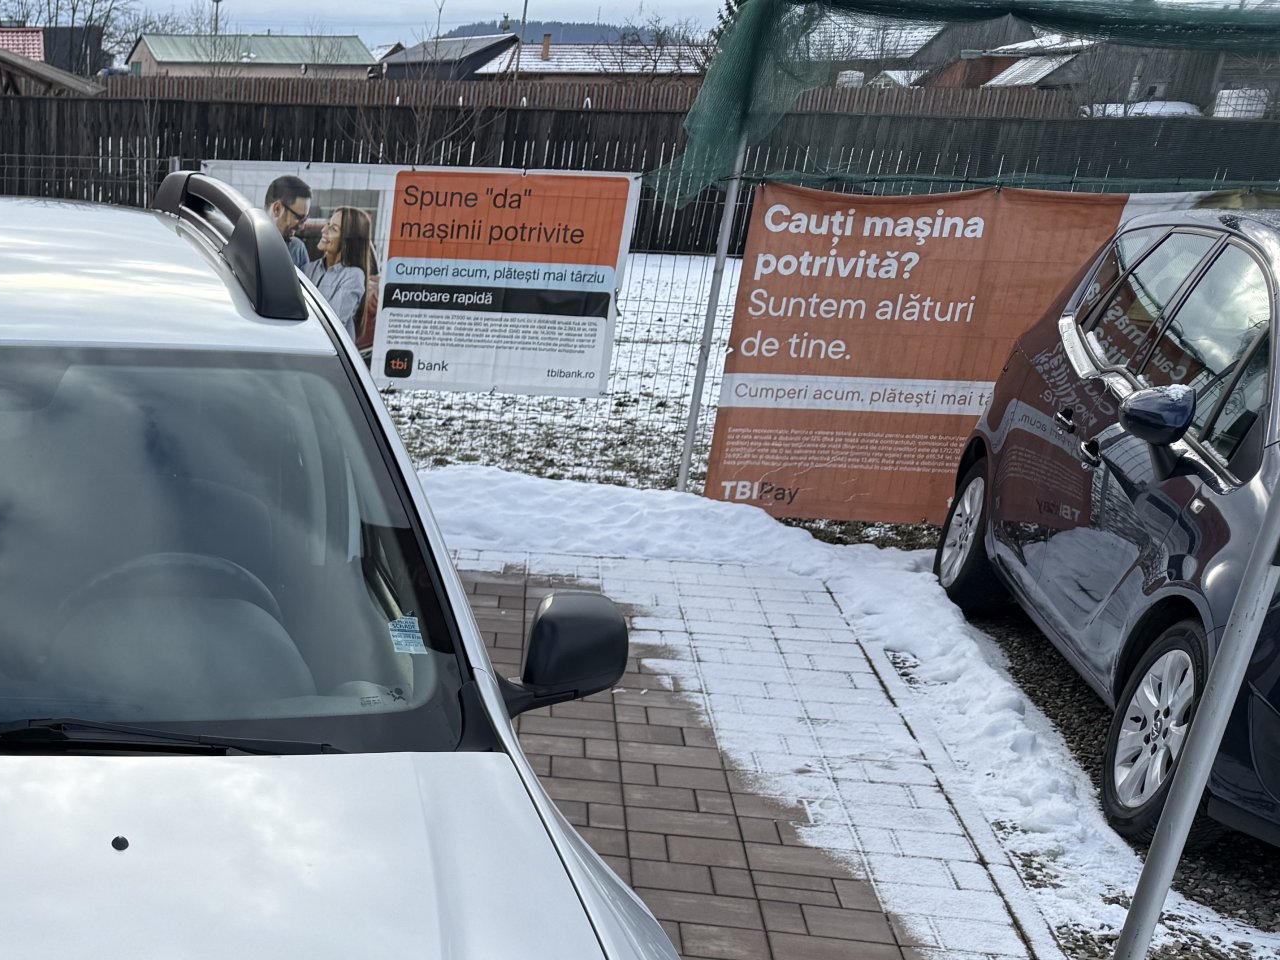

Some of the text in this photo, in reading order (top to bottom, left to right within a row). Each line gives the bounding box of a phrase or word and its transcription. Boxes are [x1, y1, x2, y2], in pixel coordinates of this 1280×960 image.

[403, 185, 533, 210] Spune "da"
[399, 219, 585, 246] mașinii potrivite
[764, 204, 856, 246] Cauți
[395, 263, 449, 279] Cumperi
[452, 266, 490, 281] acum,
[543, 270, 567, 283] mai
[571, 270, 606, 285] târziu
[754, 249, 919, 280] potrivită?
[391, 288, 493, 306] Aprobare rapidă
[748, 288, 976, 322] Suntem alături
[740, 330, 852, 360] de tine.
[389, 358, 449, 373] tbi bank
[546, 368, 596, 380] tbibank.ro
[734, 383, 809, 400] Cumperi
[940, 391, 973, 406] mai
